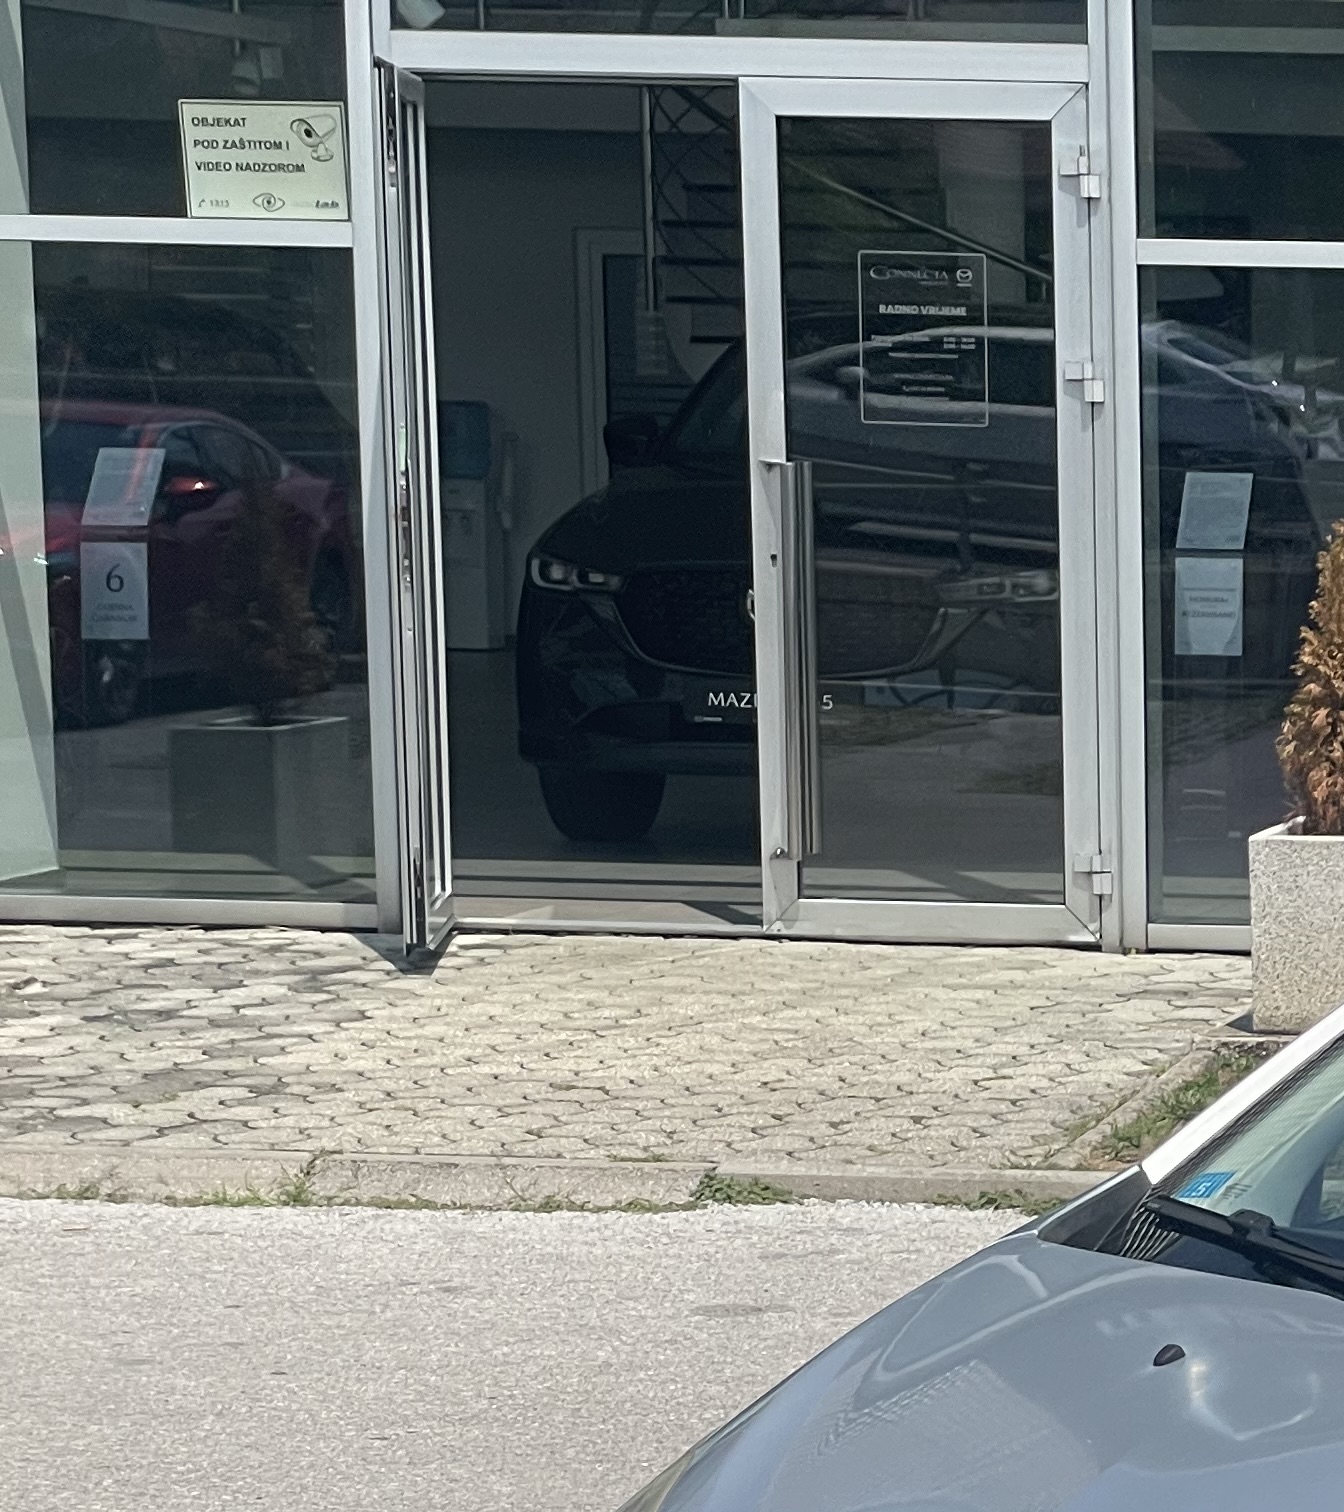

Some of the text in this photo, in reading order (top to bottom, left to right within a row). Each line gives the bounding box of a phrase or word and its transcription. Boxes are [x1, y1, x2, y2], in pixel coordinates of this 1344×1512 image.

[191, 117, 247, 128] OBJEKAT
[193, 139, 219, 150] POD
[222, 137, 283, 151] ZAŠTITOM
[195, 161, 306, 173] VIDEO NADZOROM
[878, 304, 967, 316] RADNO VRIJEME
[105, 563, 125, 593] 6
[707, 692, 758, 709] MAZ
